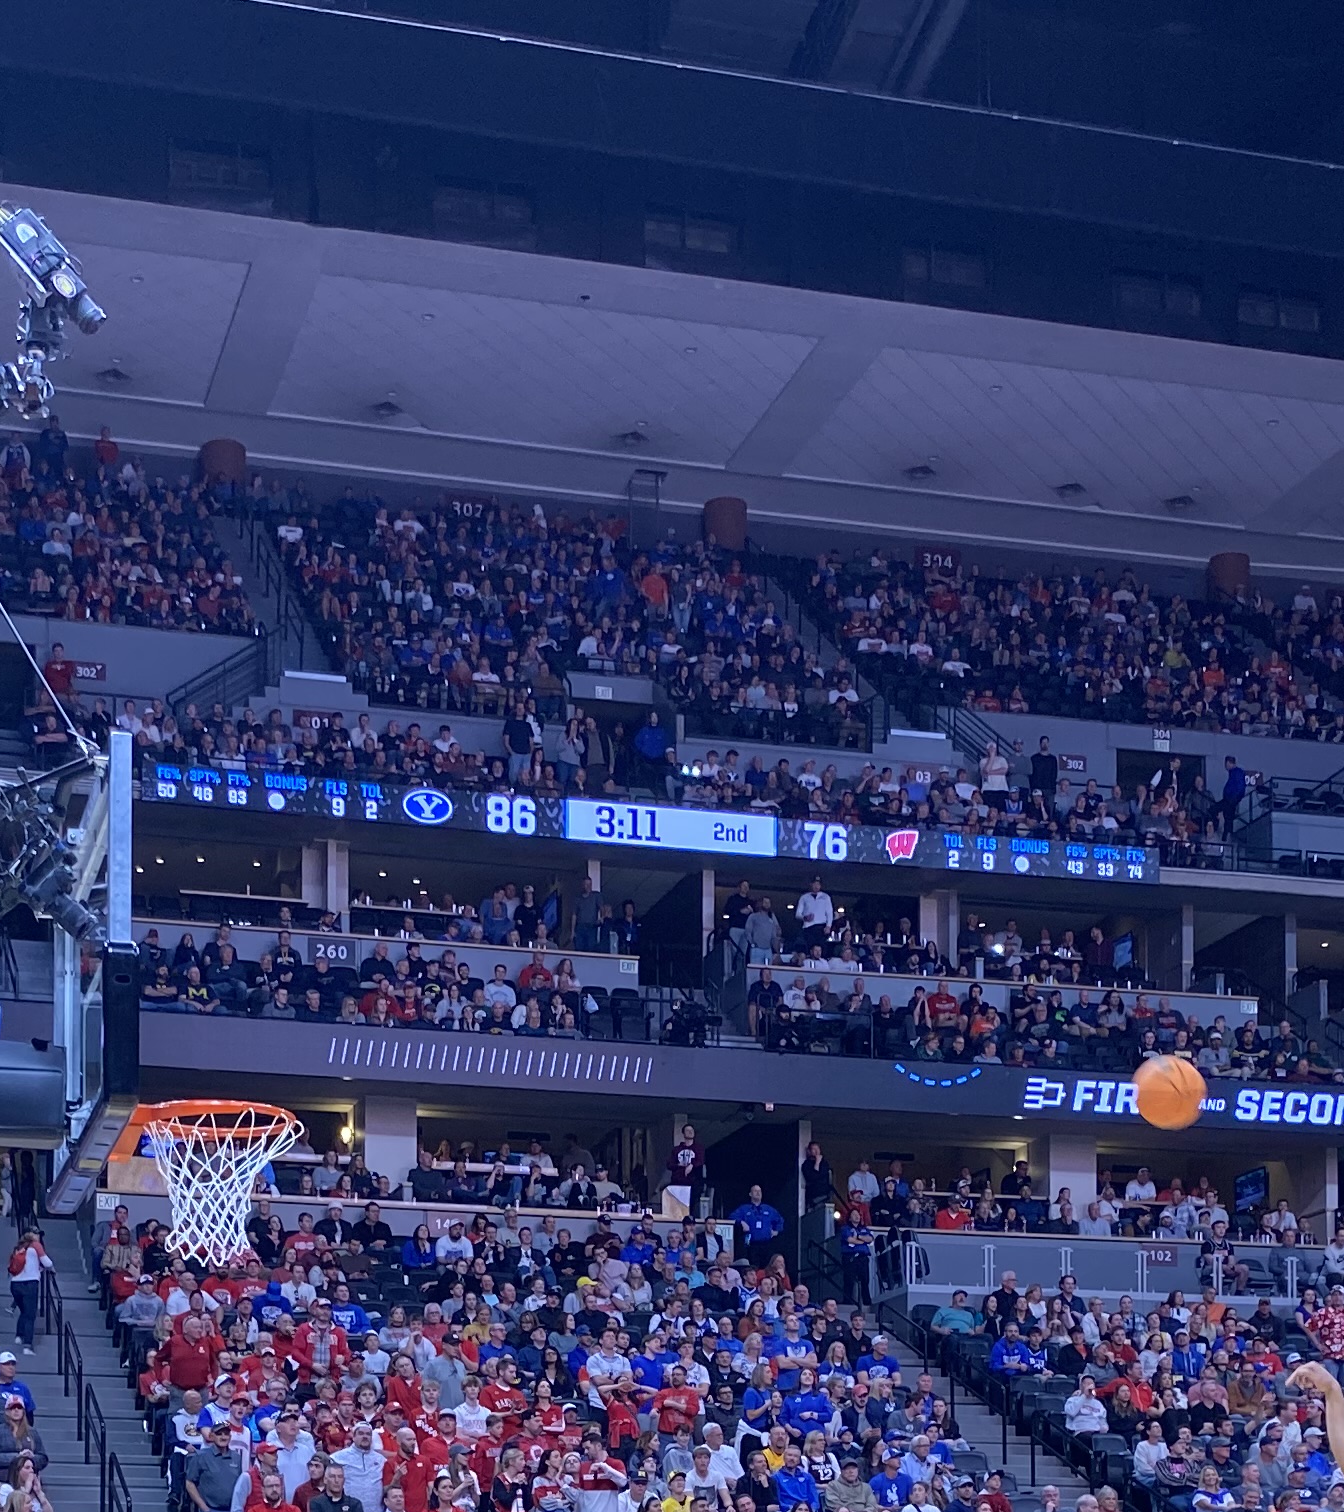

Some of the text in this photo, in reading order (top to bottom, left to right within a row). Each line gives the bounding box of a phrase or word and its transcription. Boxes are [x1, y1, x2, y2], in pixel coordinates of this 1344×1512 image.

[75, 665, 98, 678] 302
[311, 717, 329, 729] 01
[1153, 729, 1171, 739] 304
[1066, 759, 1084, 770] 302
[915, 770, 933, 783] 03
[1244, 775, 1257, 786] 06
[228, 771, 252, 787] FT%
[265, 774, 307, 792] BONUS
[325, 780, 348, 796] FLS
[360, 783, 384, 799] TOL
[158, 783, 177, 799] 50
[332, 797, 345, 816] 9
[365, 801, 378, 820] 2
[486, 793, 537, 837] 86
[595, 805, 748, 844] 3:11 2nd
[804, 822, 849, 862] 76
[944, 833, 964, 849] TOL
[977, 836, 997, 851] FLS
[1012, 839, 1050, 855] BONUS
[1126, 849, 1146, 863] FT%
[947, 850, 1143, 879] 2 9 43 33 74
[316, 944, 349, 959] 260
[1073, 1079, 1140, 1115] FIR
[1199, 1097, 1226, 1113] AND
[98, 1194, 120, 1208] EXIT
[435, 1218, 460, 1230] 14
[1149, 1249, 1173, 1262] 102
[818, 1468, 834, 1481] 12
